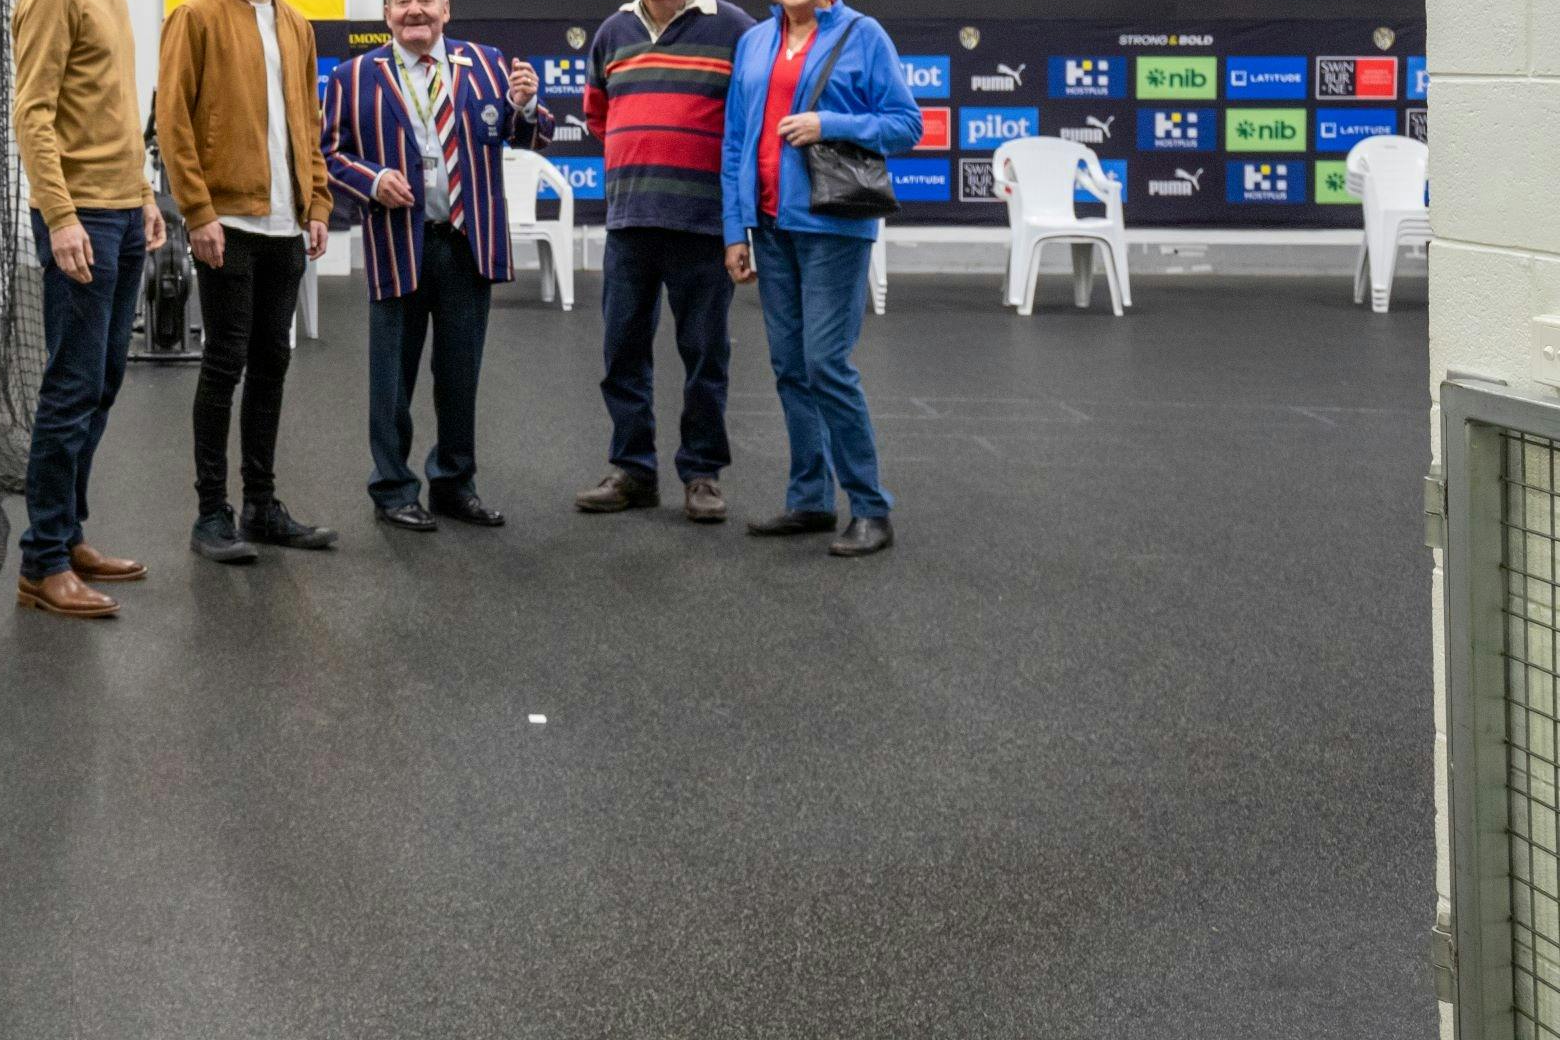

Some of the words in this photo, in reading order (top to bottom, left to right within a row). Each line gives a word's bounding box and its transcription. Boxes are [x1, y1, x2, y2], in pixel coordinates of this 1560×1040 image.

[349, 33, 392, 44] MOND
[1119, 34, 1167, 46] STRONG
[1179, 34, 1213, 46] BOLD
[900, 63, 942, 87] lot
[1169, 68, 1207, 88] nib
[1250, 73, 1301, 83] LATITUDE
[971, 75, 1014, 92] PUMA
[968, 114, 1030, 144] pilot
[1060, 127, 1103, 144] PUMA
[1258, 120, 1297, 140] nib
[1340, 125, 1392, 135] LATITUDE
[895, 176, 945, 185] LATITUDE
[1148, 180, 1193, 196] PUMA
